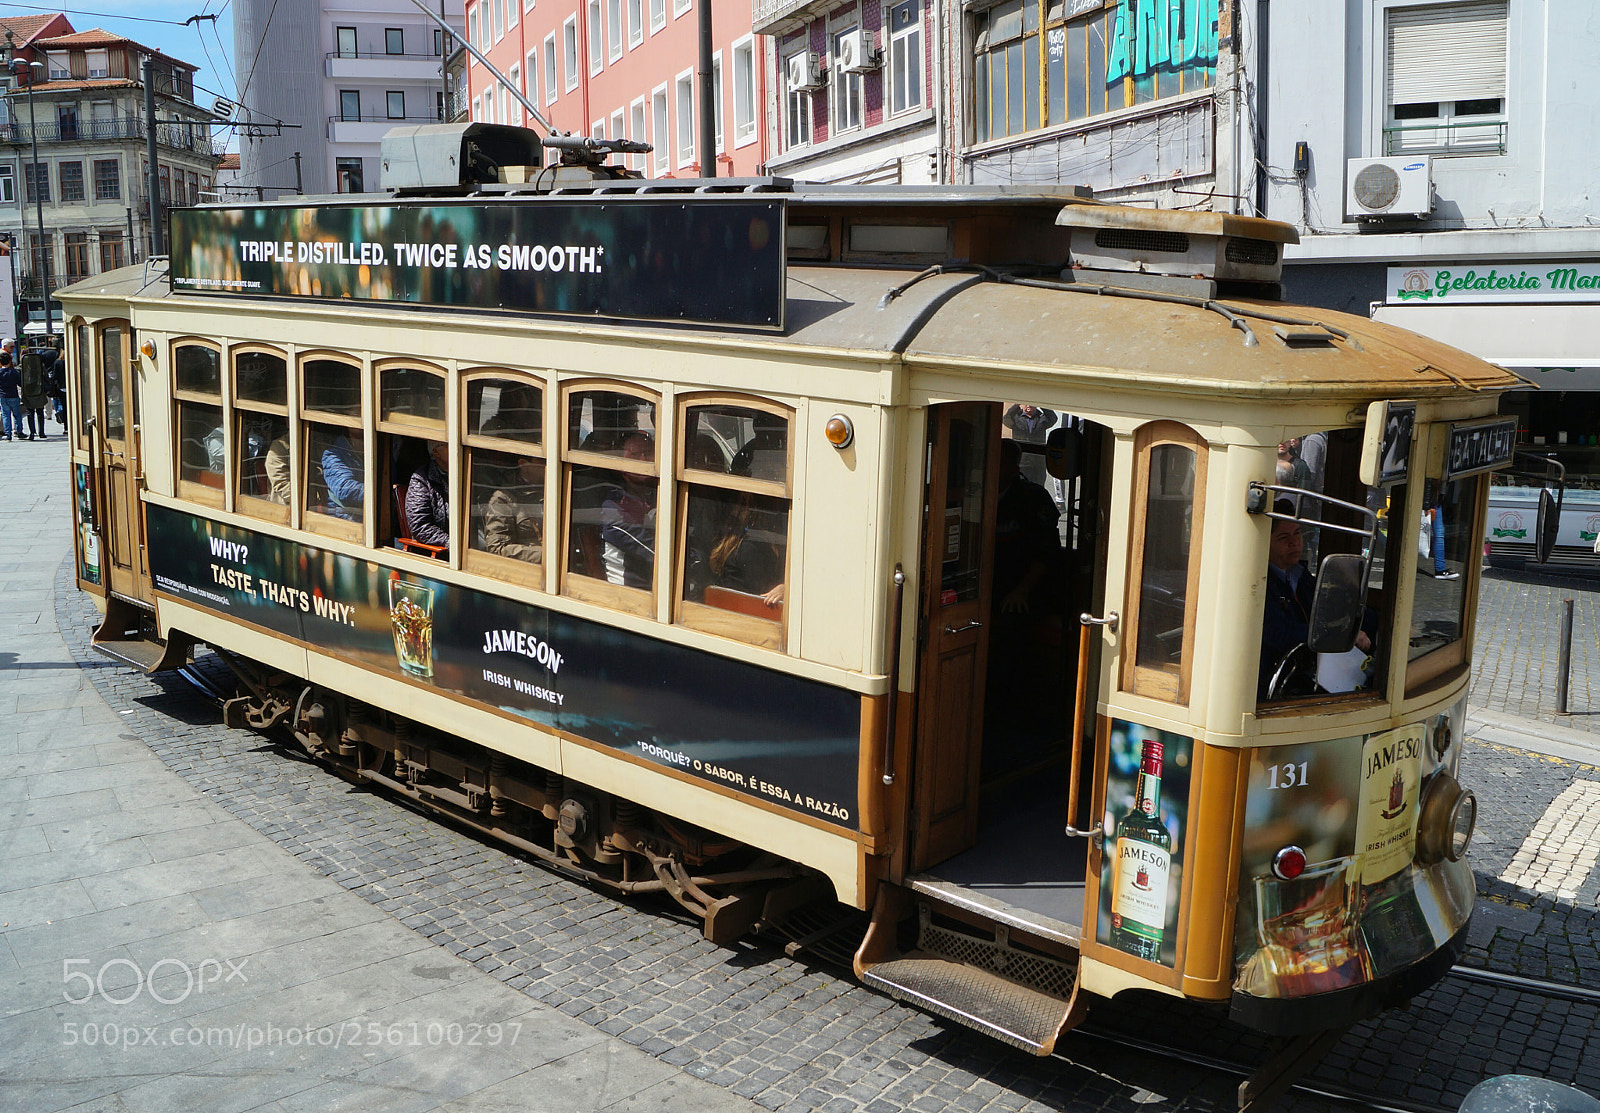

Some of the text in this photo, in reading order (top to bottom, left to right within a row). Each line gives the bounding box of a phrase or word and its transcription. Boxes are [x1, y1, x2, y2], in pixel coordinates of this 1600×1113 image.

[240, 241, 294, 263] TRIPLE
[298, 241, 388, 266] DISTILLED.
[394, 243, 457, 268] TWICE
[463, 244, 491, 269] AS
[1434, 269, 1541, 297] Gelateria
[209, 536, 248, 565] WHY?
[210, 564, 257, 599] TASTE,
[259, 578, 310, 612] THAT'S
[482, 629, 564, 675] JAMESON
[483, 669, 565, 706] IRISH WHISKEY
[693, 759, 702, 771] O
[704, 763, 747, 788] SABOR,
[750, 775, 758, 790] É
[760, 781, 792, 802] ESSA
[794, 793, 804, 806] A
[806, 796, 849, 821] RAZÃO
[1266, 761, 1309, 790] 131
[1119, 847, 1168, 872] JAMESON
[1366, 841, 1386, 852] IRISH
